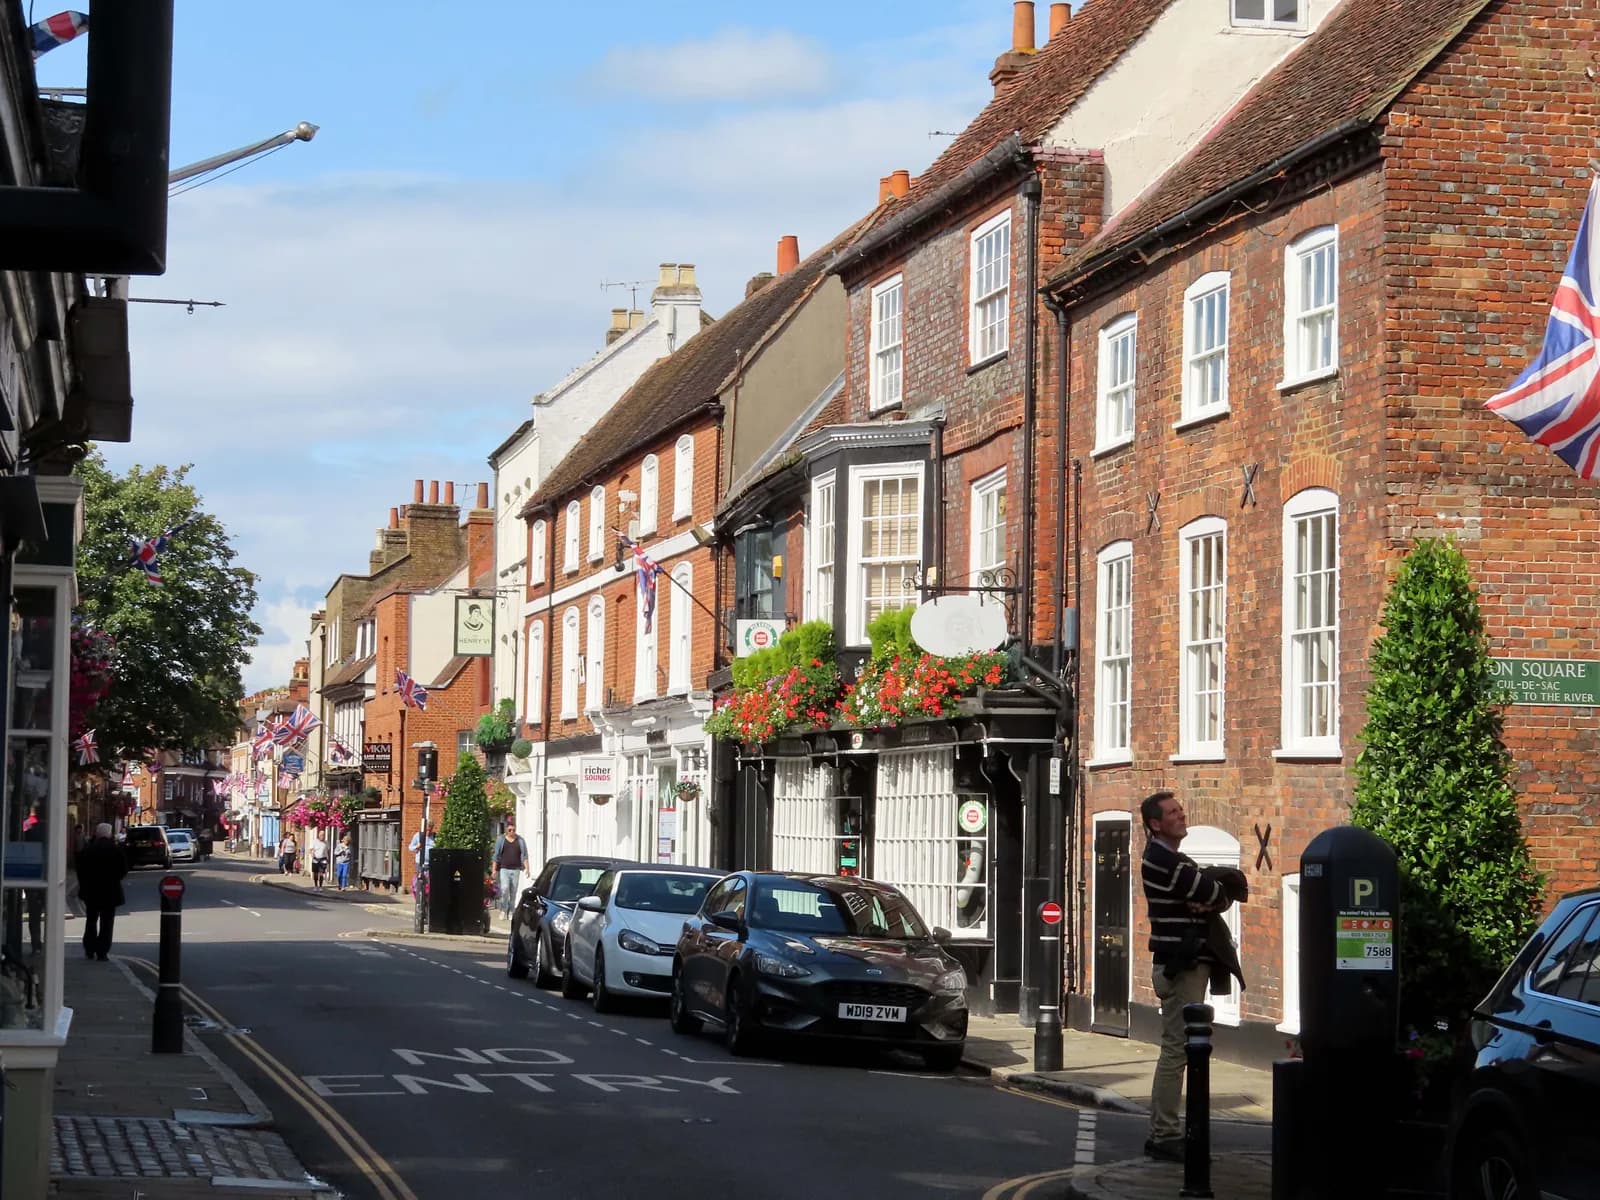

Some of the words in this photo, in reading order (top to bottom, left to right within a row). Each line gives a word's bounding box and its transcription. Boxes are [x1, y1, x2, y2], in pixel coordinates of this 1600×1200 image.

[1521, 662, 1586, 679] SQUARE
[1496, 680, 1560, 690] CUL-DE-SAC
[1523, 692, 1537, 700] TO
[1540, 692, 1560, 702] THE
[1564, 693, 1594, 702] RIVER
[364, 744, 390, 752] MKM
[584, 766, 610, 774] richer
[1354, 879, 1373, 906] P
[1366, 946, 1392, 956] 7588
[846, 1004, 872, 1018] WD19
[876, 1006, 899, 1019] ZVM
[392, 1048, 574, 1065] NO
[304, 1073, 741, 1096] ENTRY
